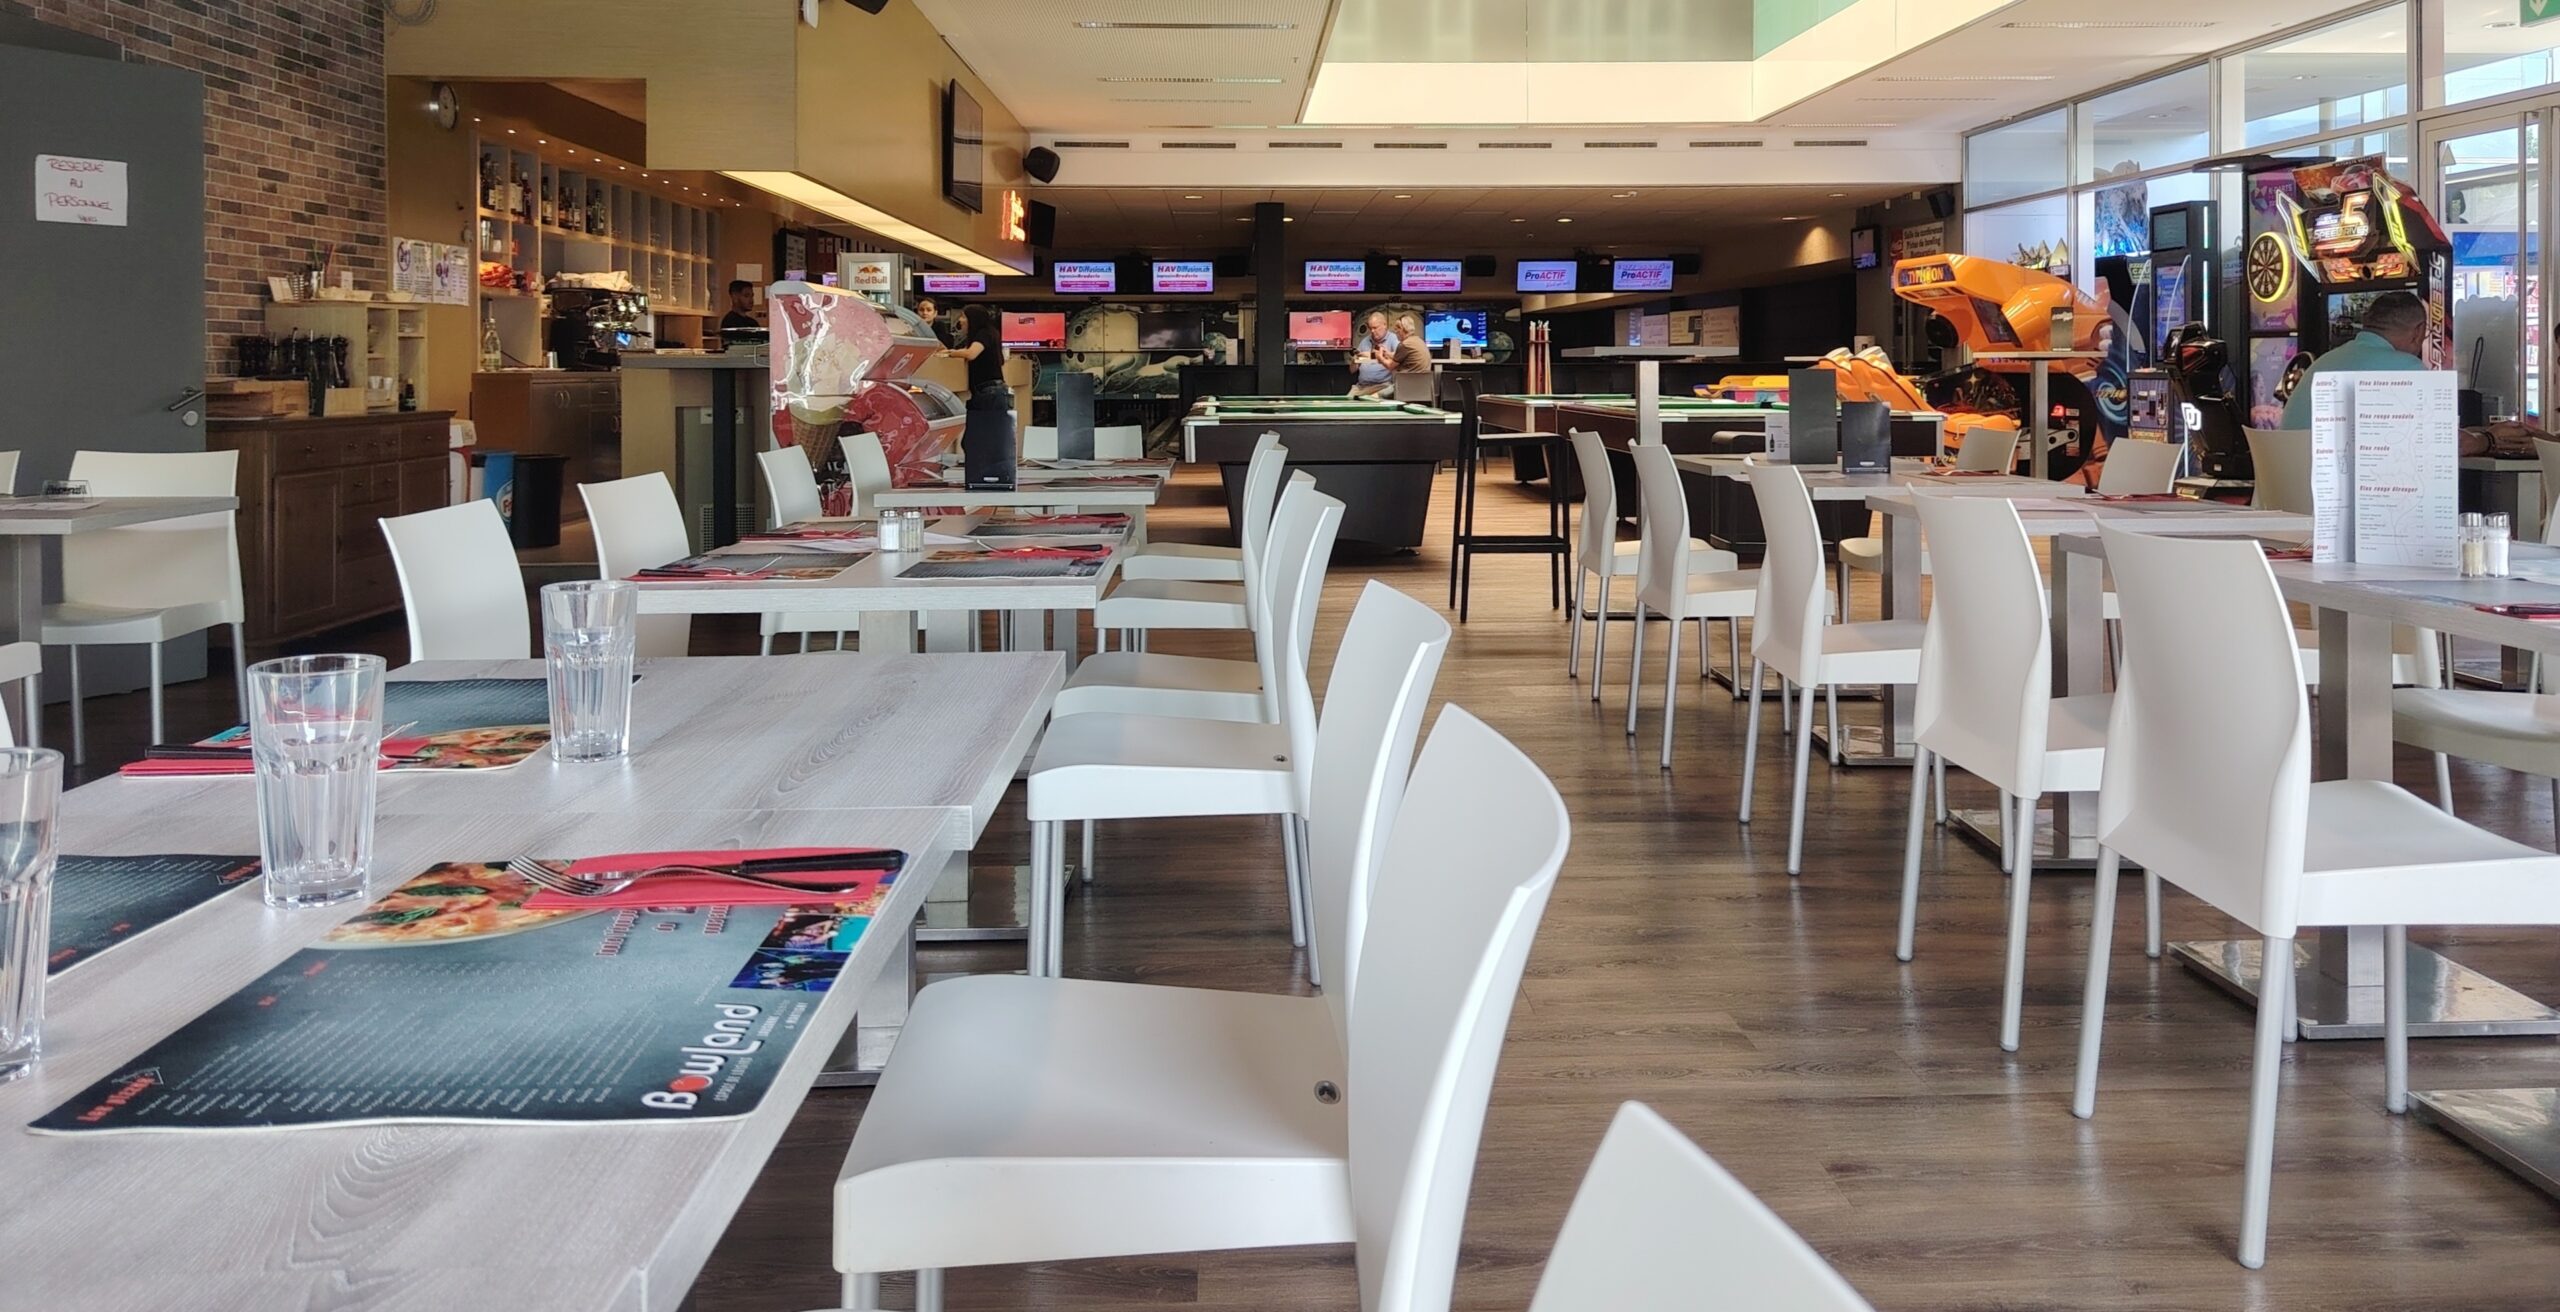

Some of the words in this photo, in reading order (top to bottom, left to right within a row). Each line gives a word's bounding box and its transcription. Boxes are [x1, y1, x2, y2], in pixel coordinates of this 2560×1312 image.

[70, 177, 83, 189] AU
[1524, 271, 1566, 281] ProACTIF
[1621, 270, 1663, 279] ProACTIF
[854, 276, 870, 284] Red
[871, 276, 888, 284] Bull
[641, 1002, 765, 1110] BowLand
